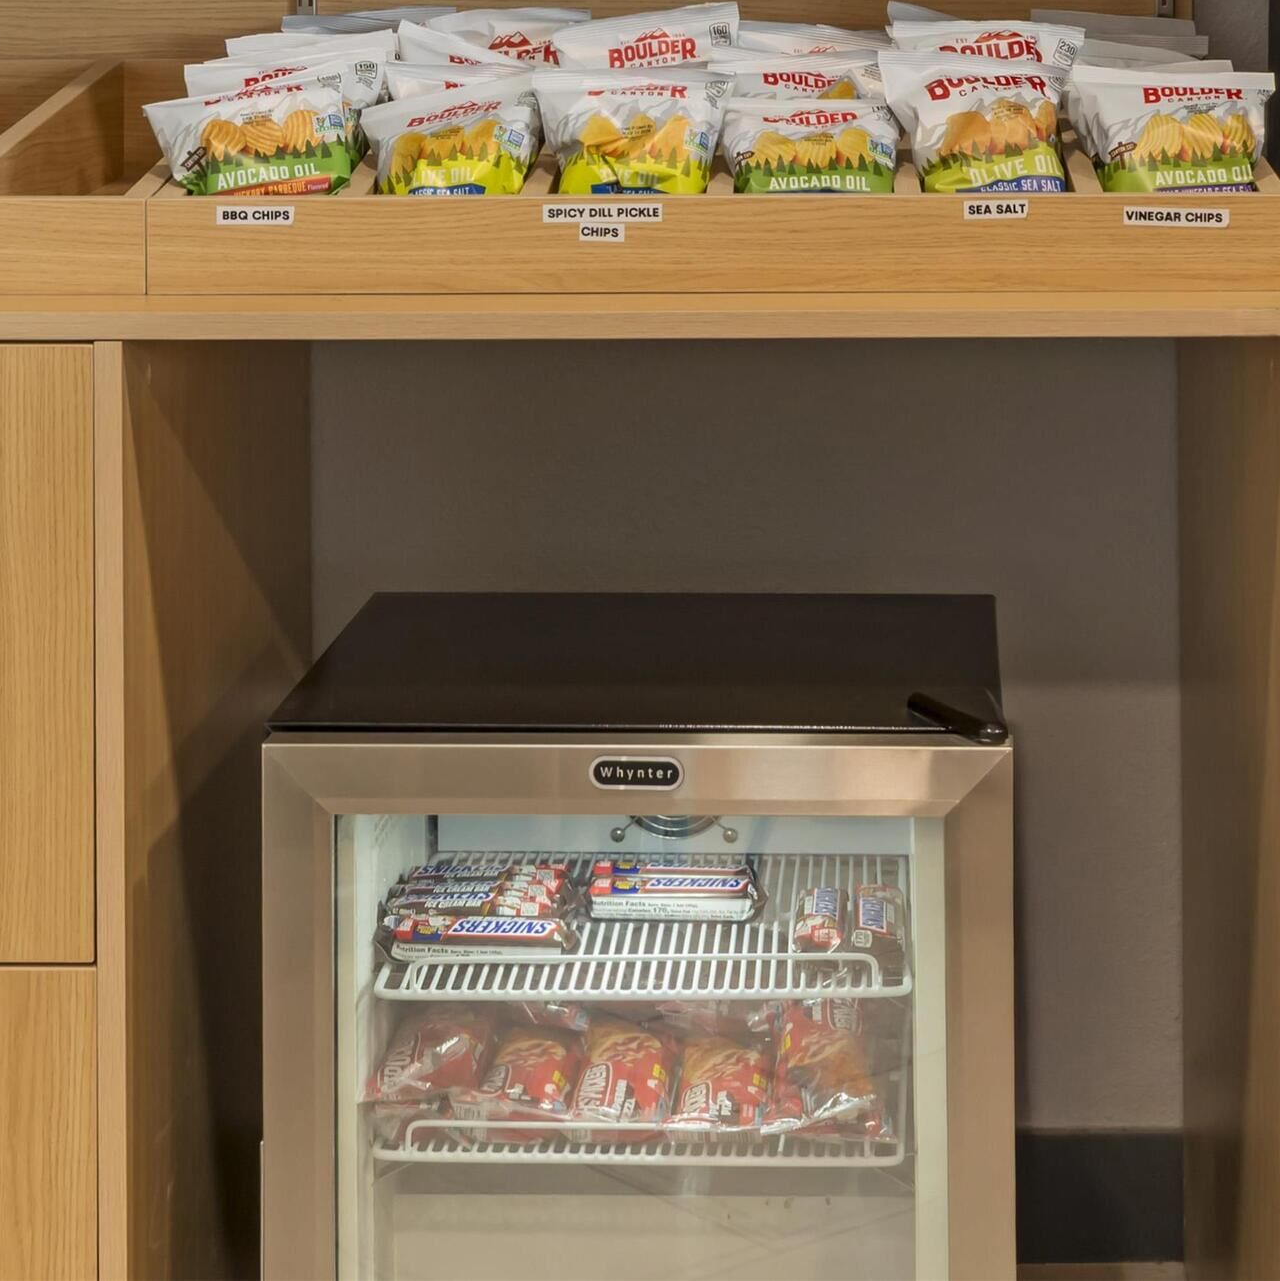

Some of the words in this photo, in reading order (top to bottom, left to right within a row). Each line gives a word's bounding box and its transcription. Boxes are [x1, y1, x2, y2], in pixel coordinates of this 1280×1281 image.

[608, 38, 697, 68] BOULDER
[1060, 40, 1076, 56] 230
[217, 165, 288, 191] AVOCADO
[294, 163, 321, 180] OIL
[769, 175, 841, 191] AVOCADO
[846, 175, 871, 191] OIL
[222, 210, 248, 221] BBQ
[252, 210, 290, 221] CHIPS
[547, 207, 586, 219] SPICY
[589, 208, 613, 218] DILL
[617, 207, 660, 218] PICKLE
[968, 204, 993, 215] SEA
[996, 203, 1026, 215] SALT
[1125, 211, 1181, 223] VINEGAR
[1185, 212, 1223, 223] CHIPS
[581, 227, 619, 238] CHIPS
[600, 765, 674, 781] Whynter
[453, 919, 551, 934] SNICKERS
